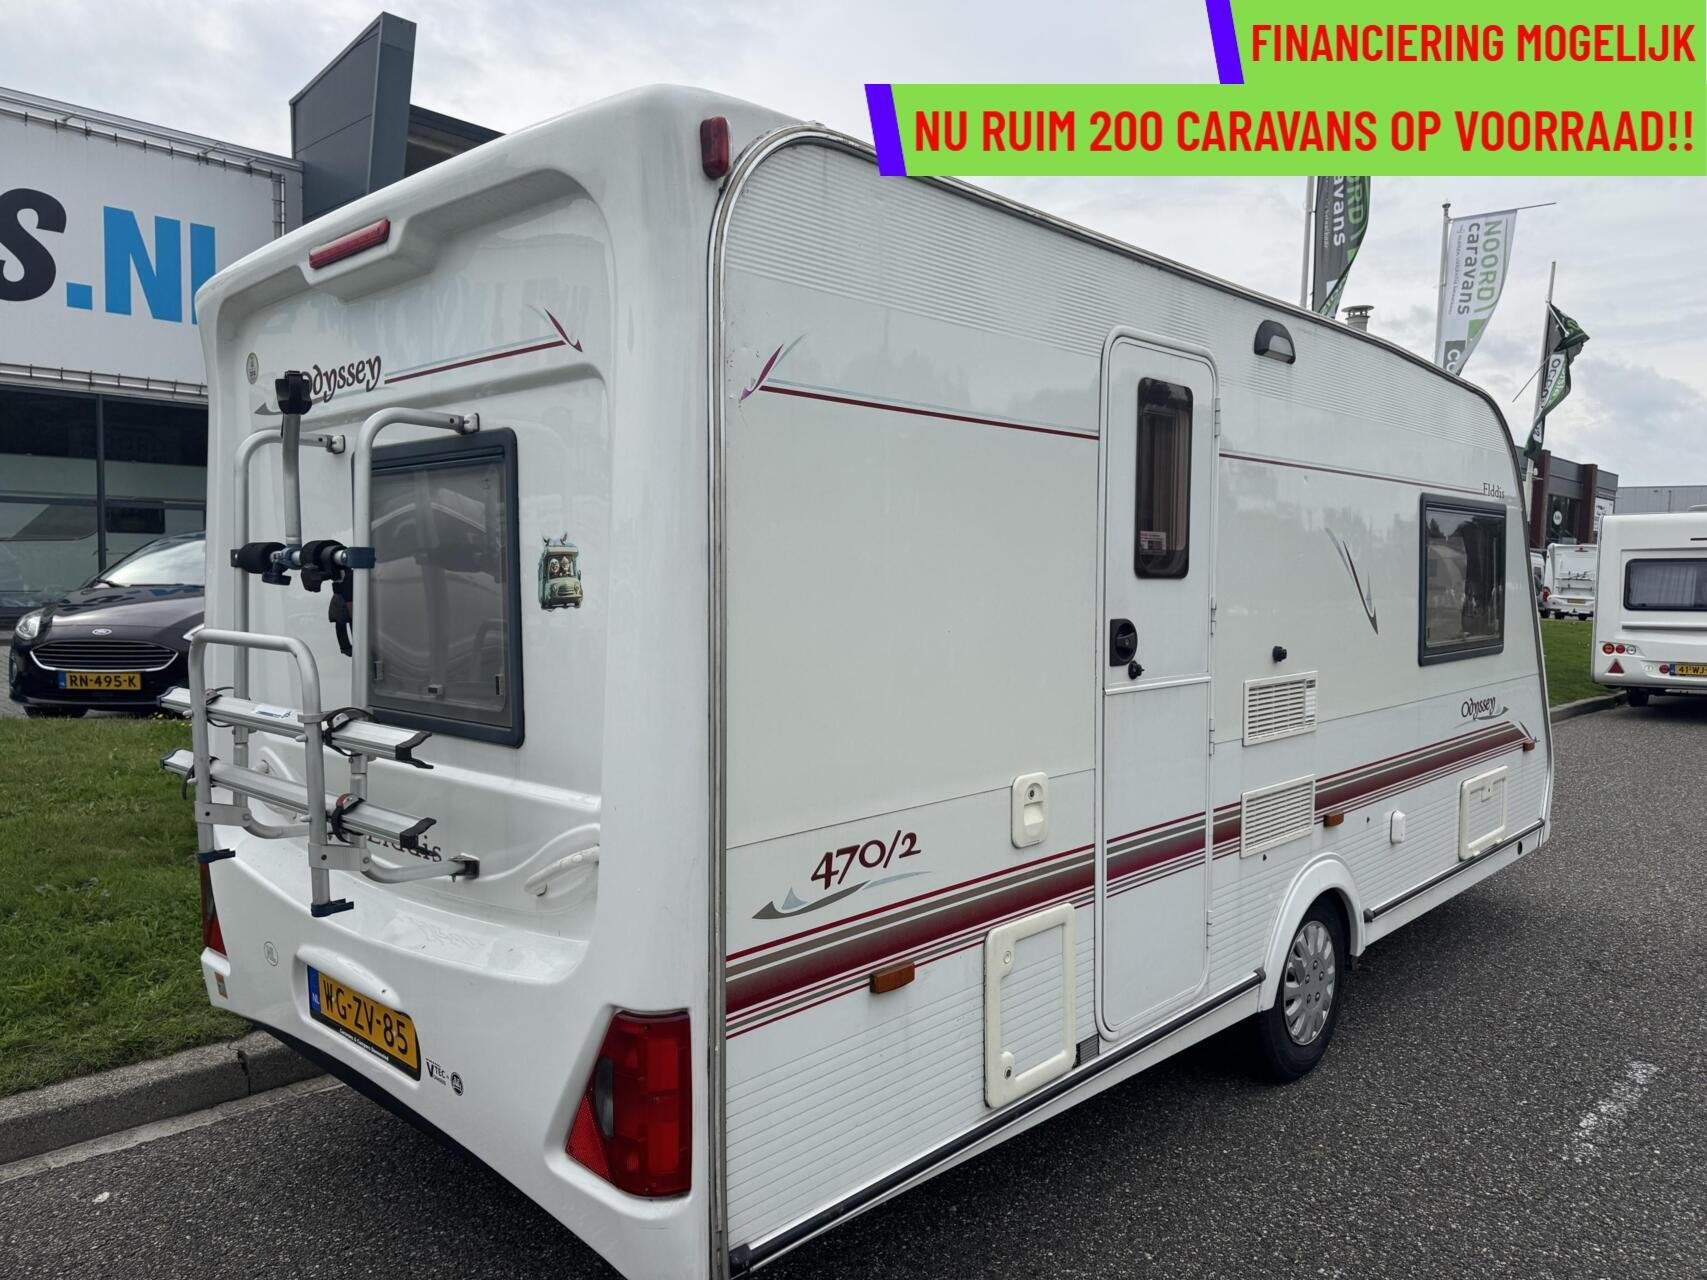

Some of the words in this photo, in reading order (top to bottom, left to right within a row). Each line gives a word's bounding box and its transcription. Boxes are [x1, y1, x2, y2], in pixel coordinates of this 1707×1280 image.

[1457, 222, 1481, 316] caravans
[1476, 219, 1503, 302] NOORD
[69, 674, 136, 688] RN-495-K
[1461, 696, 1496, 720] Odyssey
[810, 829, 922, 890] 470/2
[322, 979, 408, 1056] WG-ZV-85
